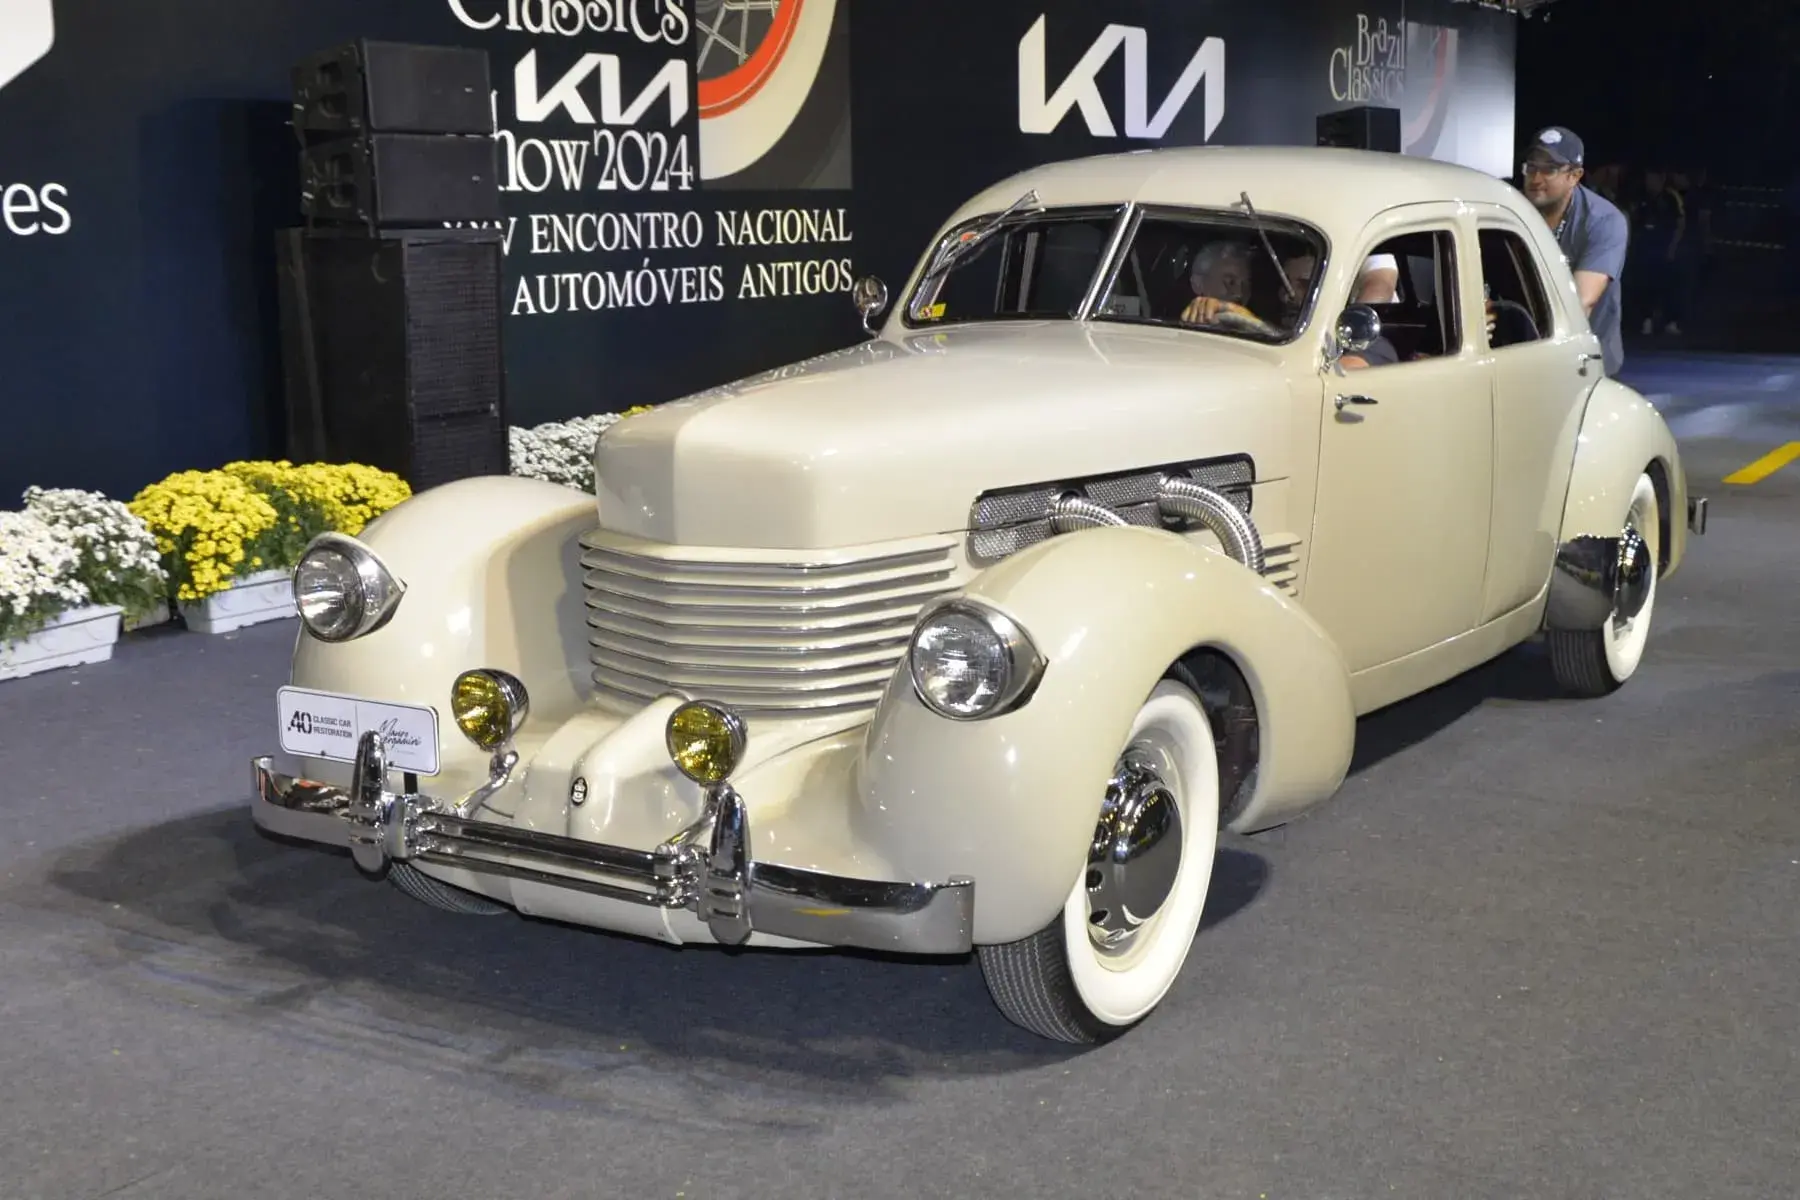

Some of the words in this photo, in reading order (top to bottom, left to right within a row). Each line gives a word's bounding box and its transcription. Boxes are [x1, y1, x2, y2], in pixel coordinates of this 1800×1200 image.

[1356, 14, 1405, 69] Brazil
[514, 48, 689, 127] KIA
[1018, 13, 1225, 142] KIA
[1329, 46, 1405, 102] Classics
[490, 89, 590, 192] how
[593, 129, 693, 191] 2024
[0, 182, 71, 235] es
[529, 211, 703, 254] ENCONTRO
[715, 208, 852, 246] NACIONAL
[510, 257, 724, 315] AUTOMÓVEIS
[737, 258, 852, 299] ANTIGOS
[313, 716, 338, 726] CLASSIC
[339, 719, 351, 728] CAR
[313, 726, 353, 738] RESTORATION
